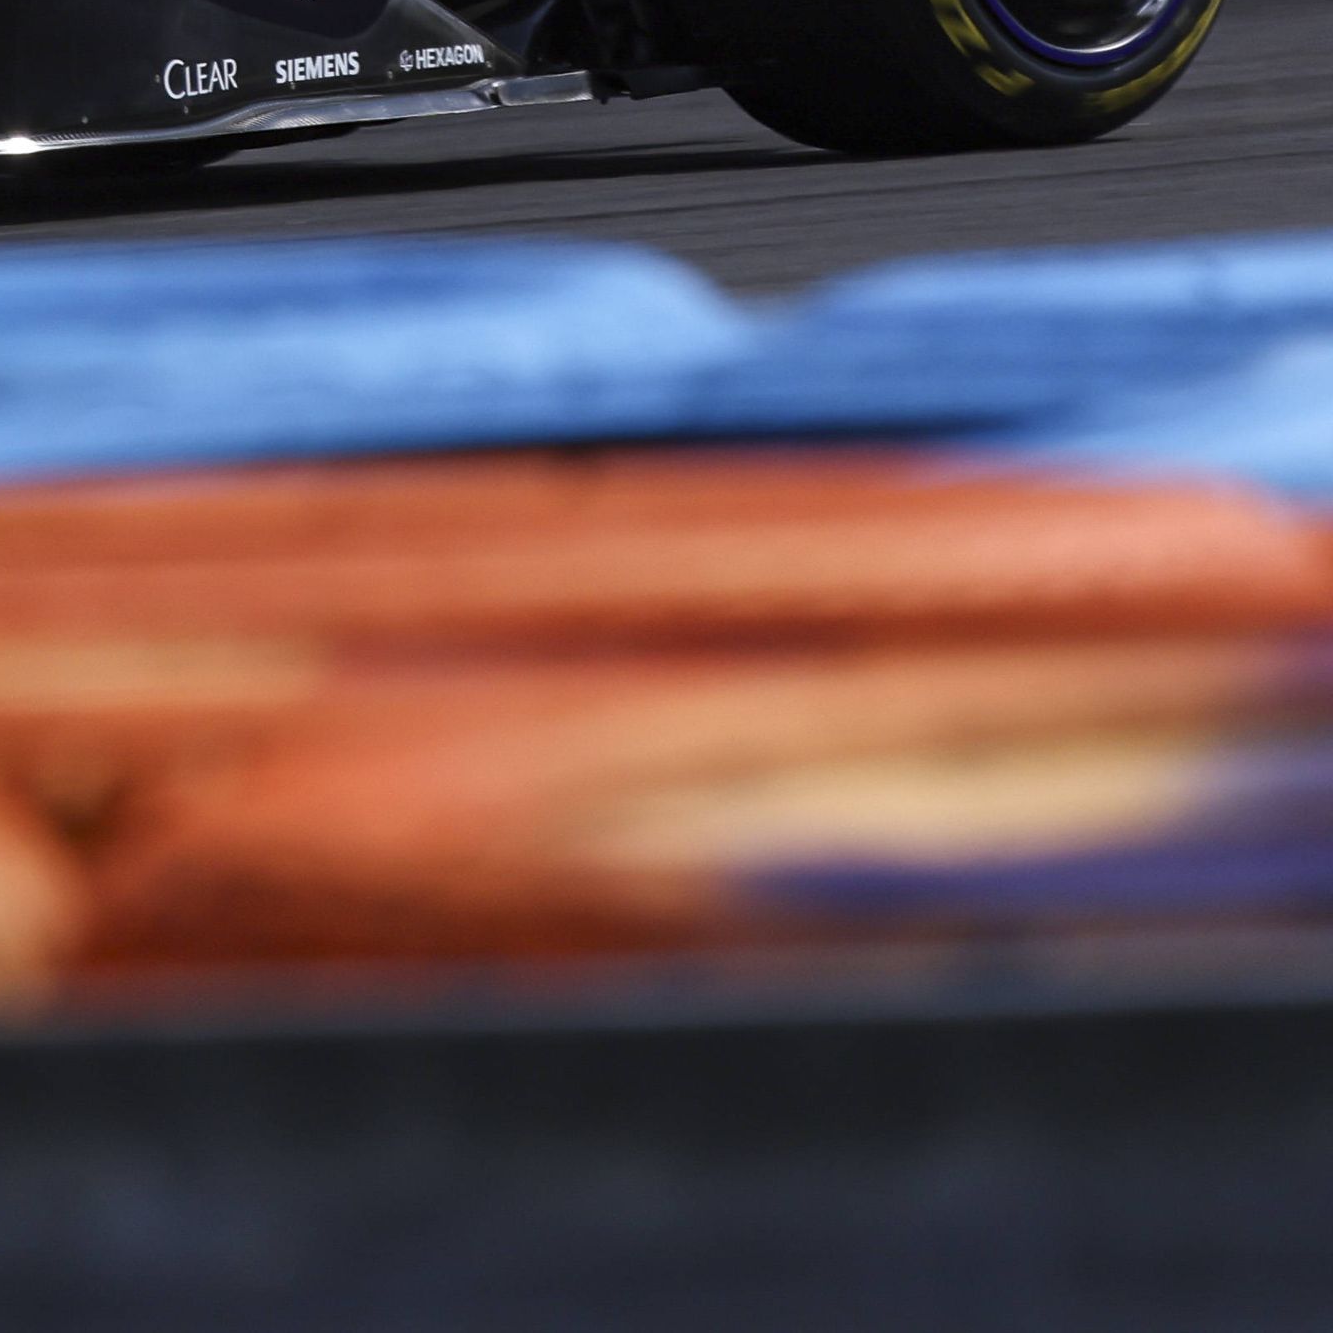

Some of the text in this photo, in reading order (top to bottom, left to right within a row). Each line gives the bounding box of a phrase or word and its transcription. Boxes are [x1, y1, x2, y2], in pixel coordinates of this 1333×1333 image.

[275, 51, 360, 84] SIEMENS
[415, 43, 486, 69] HEXAGON
[162, 58, 239, 100] CLEAR
